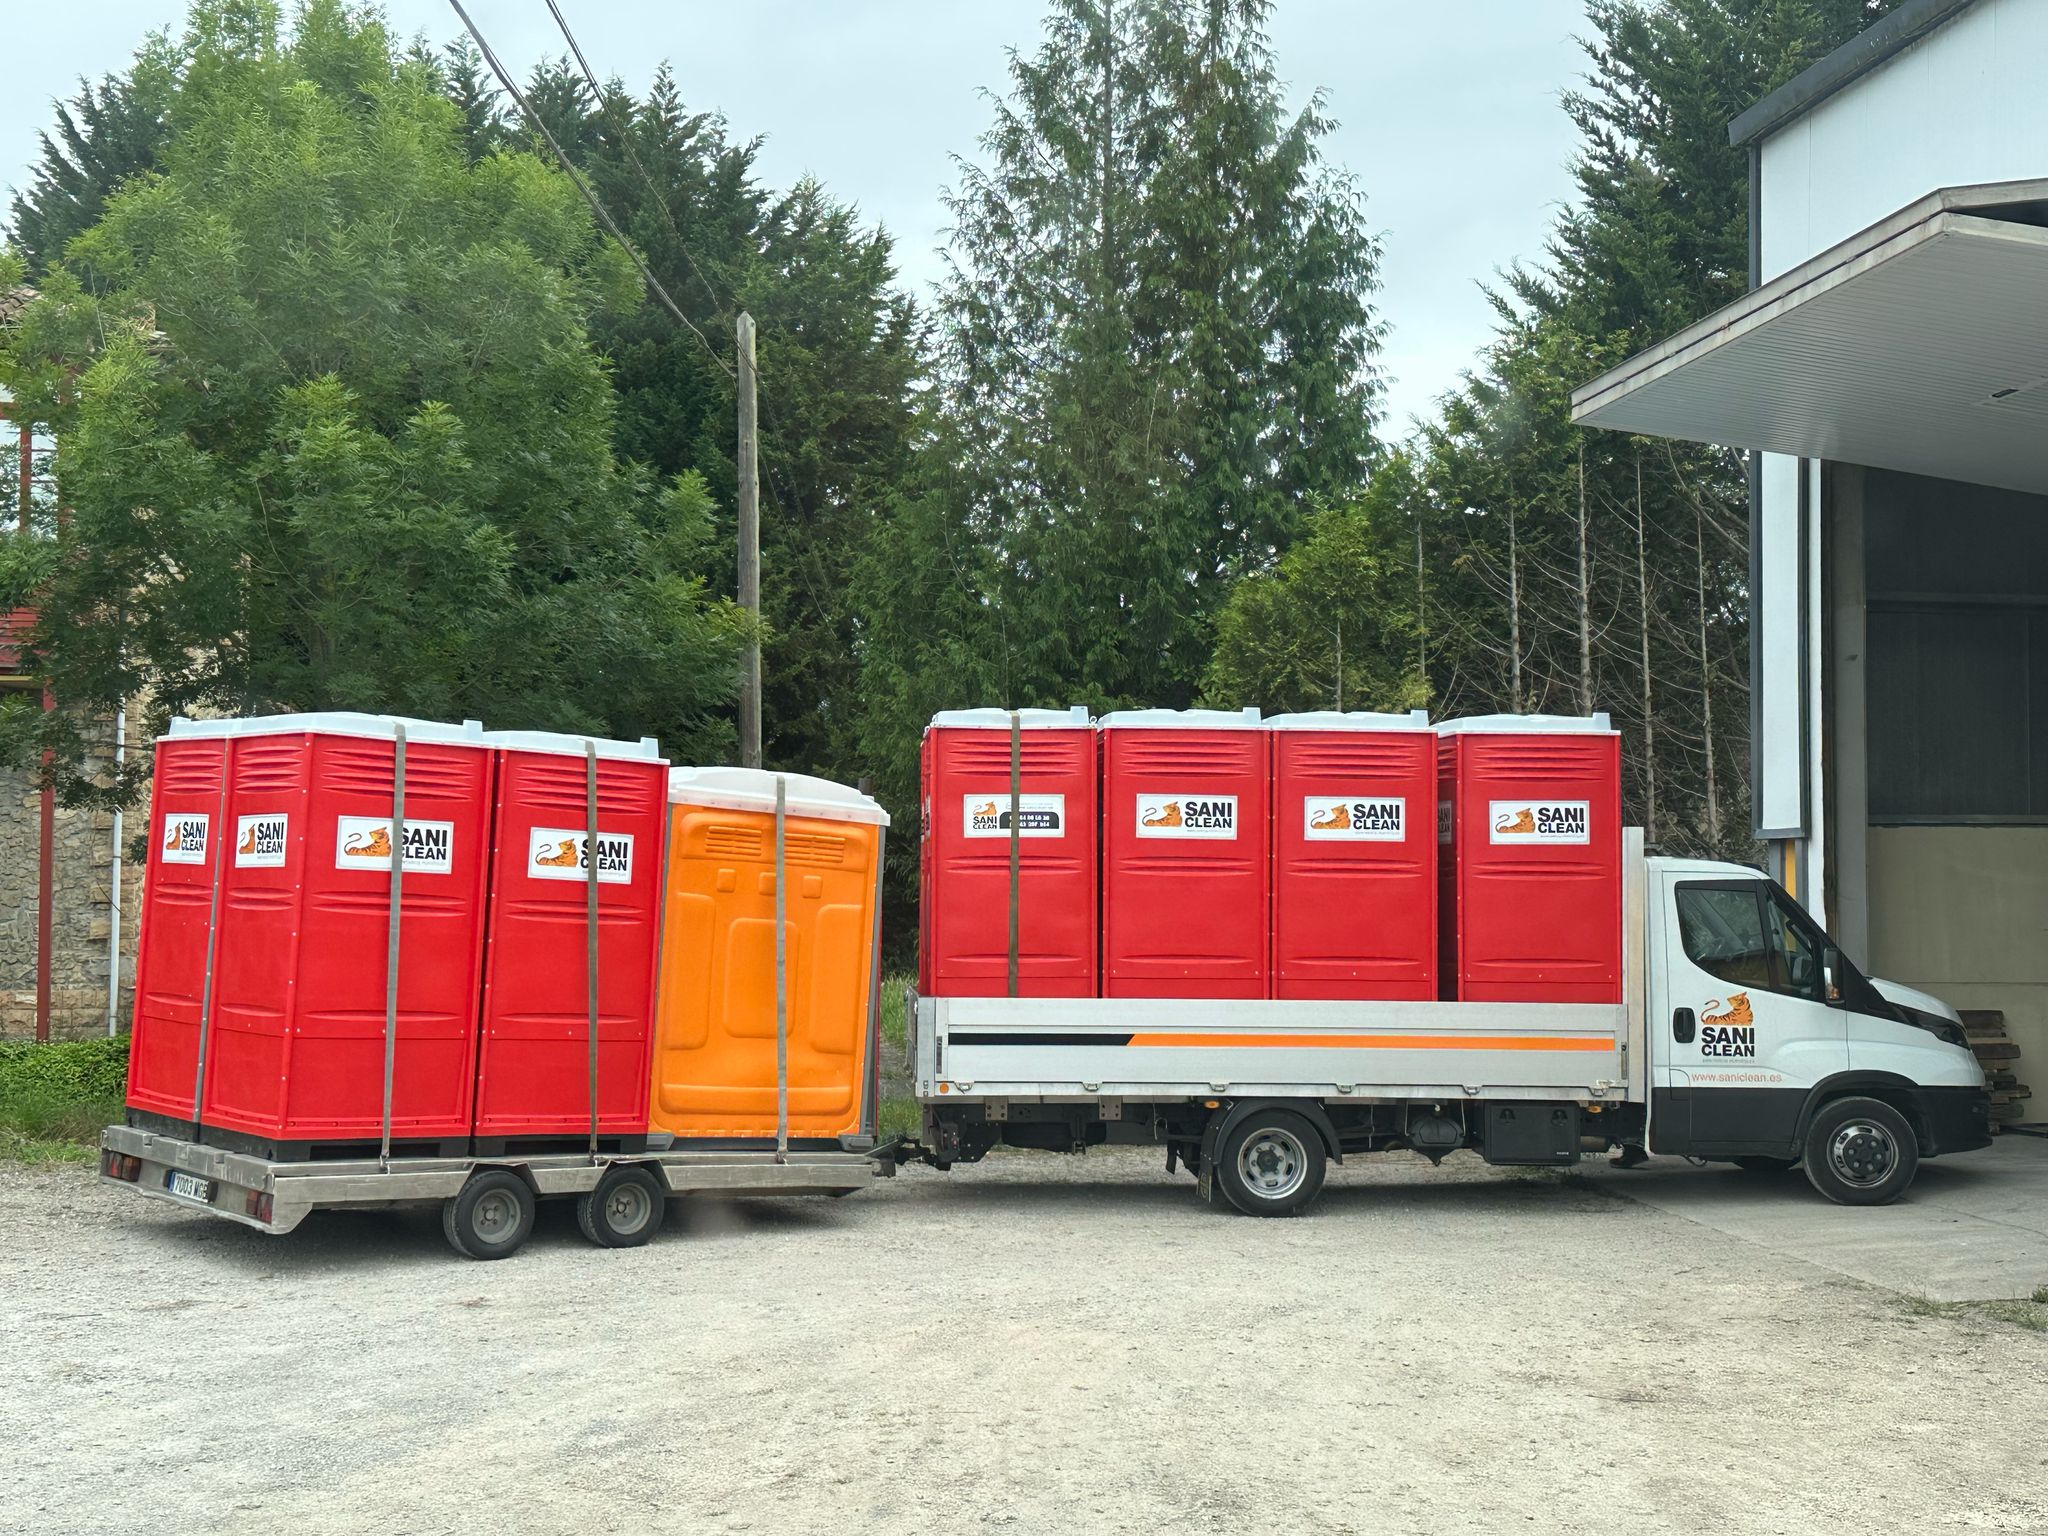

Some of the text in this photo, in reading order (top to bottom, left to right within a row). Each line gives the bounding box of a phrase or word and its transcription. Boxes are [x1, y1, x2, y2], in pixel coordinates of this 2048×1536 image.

[1185, 802, 1232, 817] SANI
[1353, 803, 1400, 819] SANI
[1537, 807, 1585, 822] SANI
[973, 816, 997, 824] SANI
[1185, 817, 1232, 828] CLEAN
[1353, 819, 1400, 830] CLEAN
[182, 821, 206, 839] SANI
[257, 822, 285, 840] SANI
[1537, 822, 1585, 833] CLEAN
[181, 839, 204, 851] CLEAN
[256, 840, 283, 853] CLEAN
[402, 846, 447, 860] LEAN
[580, 856, 627, 871] CEAN
[1701, 1026, 1755, 1044] SANI
[1701, 1044, 1755, 1057] CLEAN
[1691, 1072, 1782, 1083] www.saniclean.es
[175, 1176, 193, 1195] 7003
